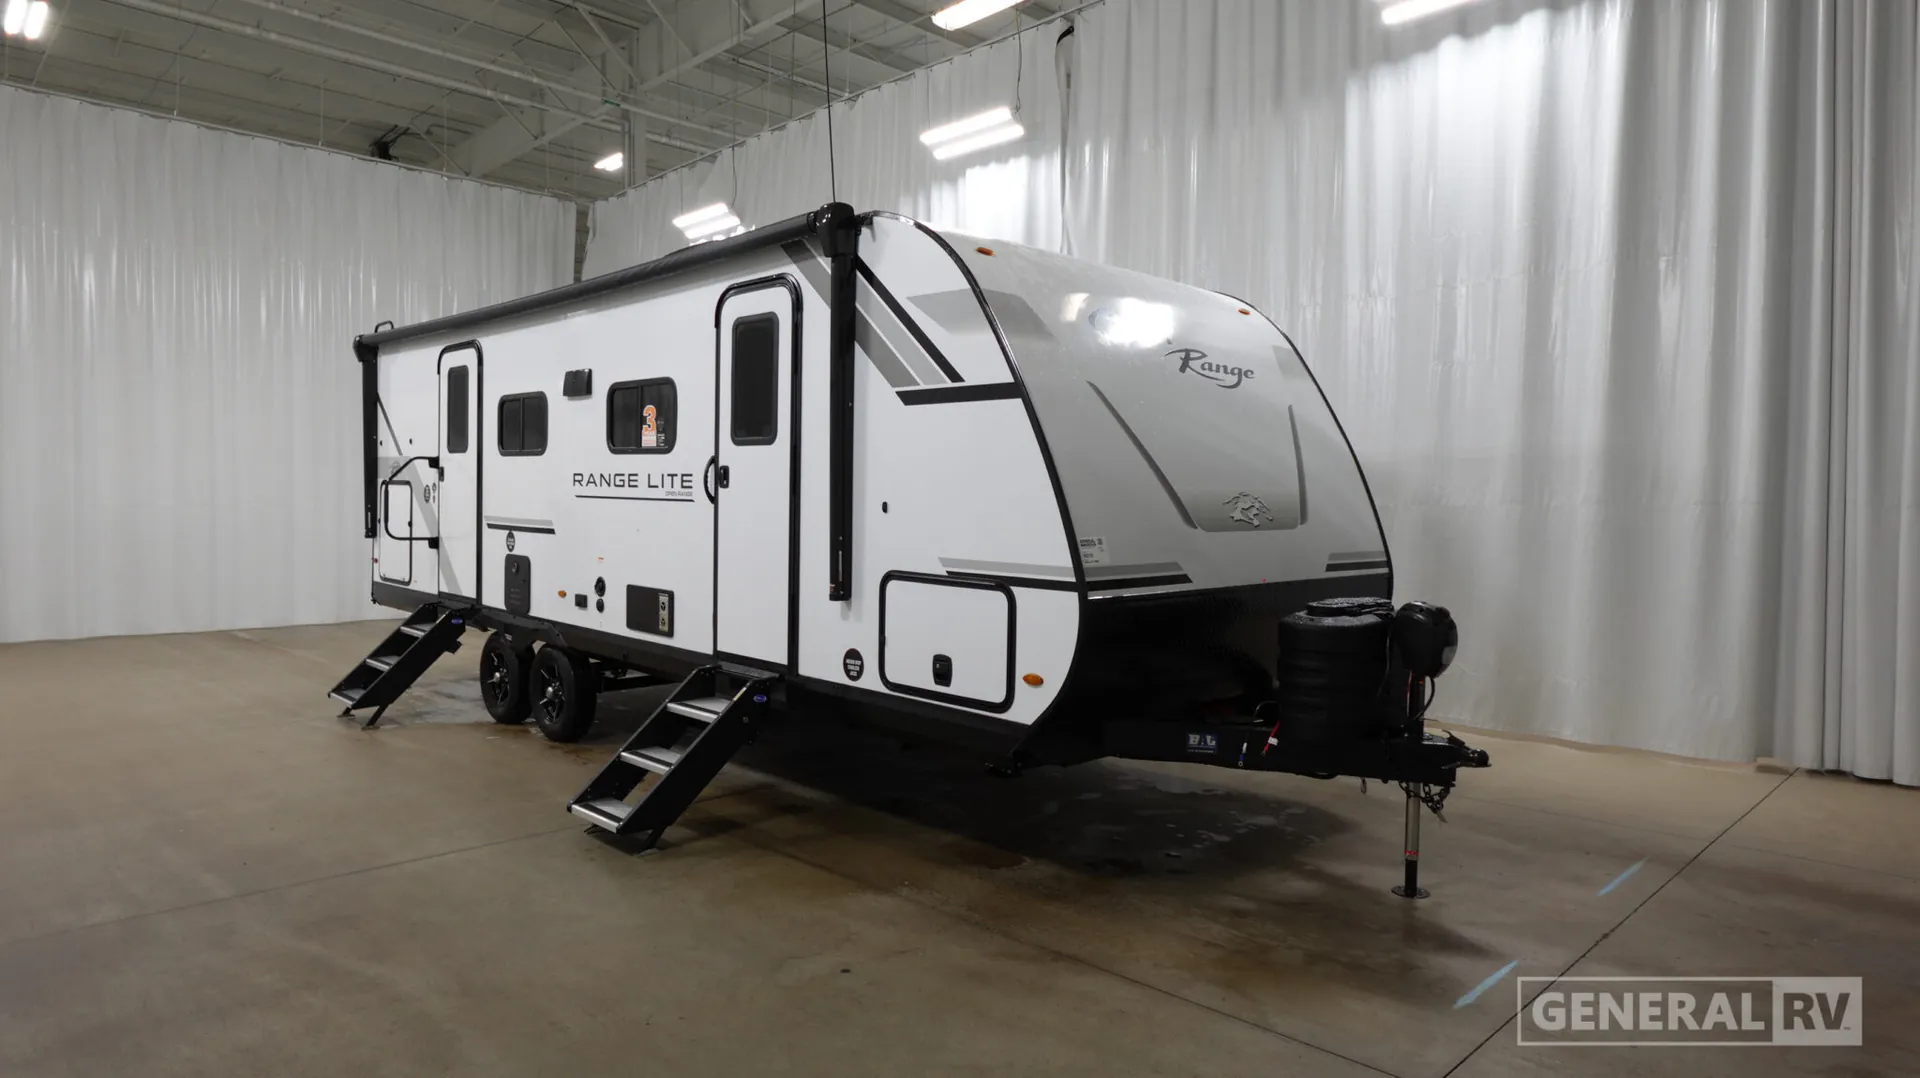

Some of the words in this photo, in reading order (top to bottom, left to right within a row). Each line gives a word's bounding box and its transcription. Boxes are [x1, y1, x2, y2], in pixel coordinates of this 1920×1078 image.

[1165, 348, 1256, 389] Range
[643, 405, 656, 432] 3
[573, 473, 639, 488] RANGE
[647, 473, 693, 489] LITE
